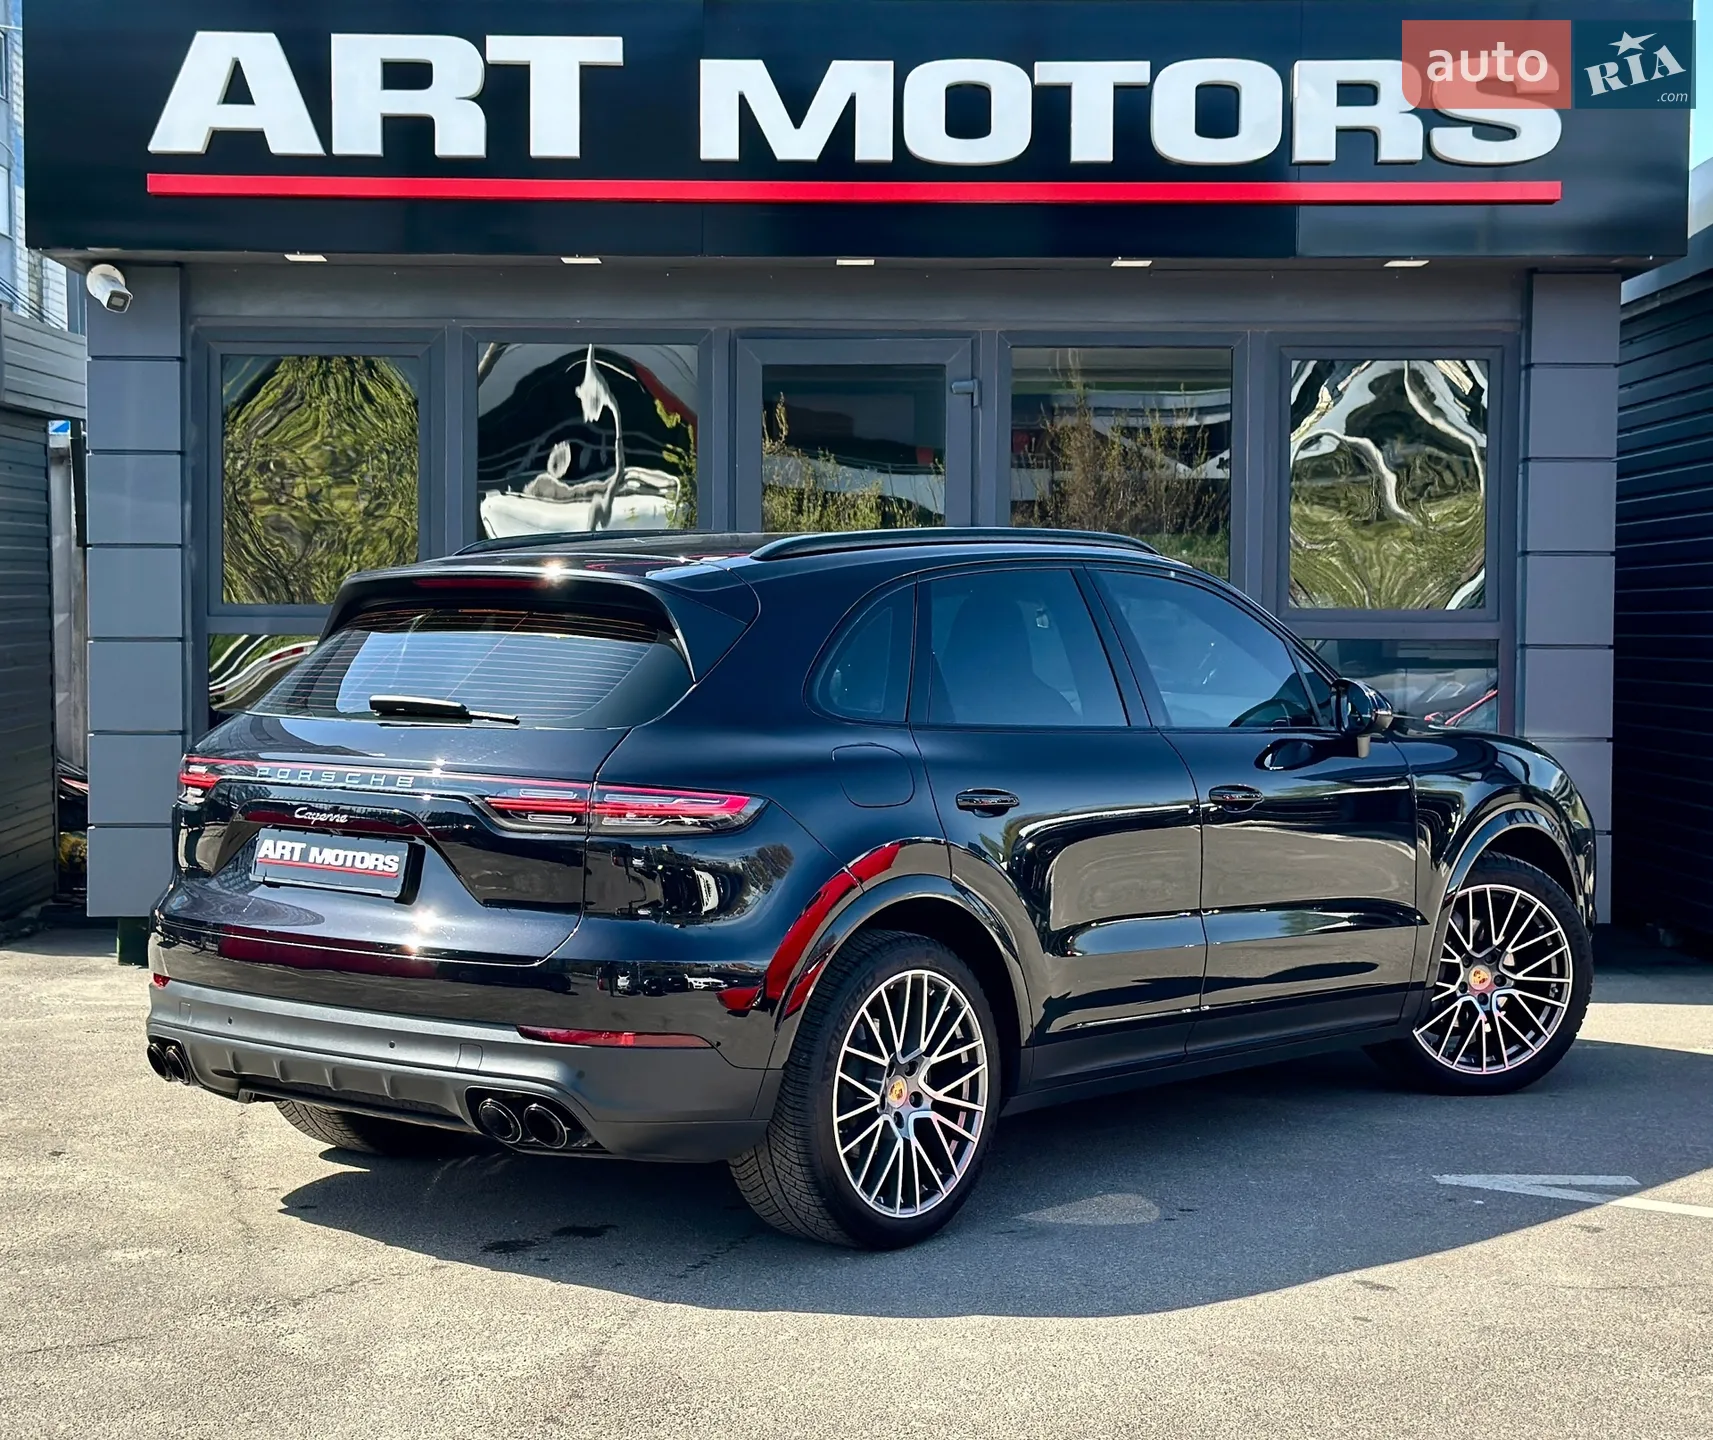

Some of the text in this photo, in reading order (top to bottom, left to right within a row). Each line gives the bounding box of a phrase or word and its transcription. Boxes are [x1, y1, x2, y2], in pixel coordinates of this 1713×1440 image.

[147, 30, 1562, 165] ART MOTORS
[256, 766, 415, 788] PORSCHE
[293, 806, 349, 825] Cayenne
[257, 839, 400, 873] ART MOTORS
